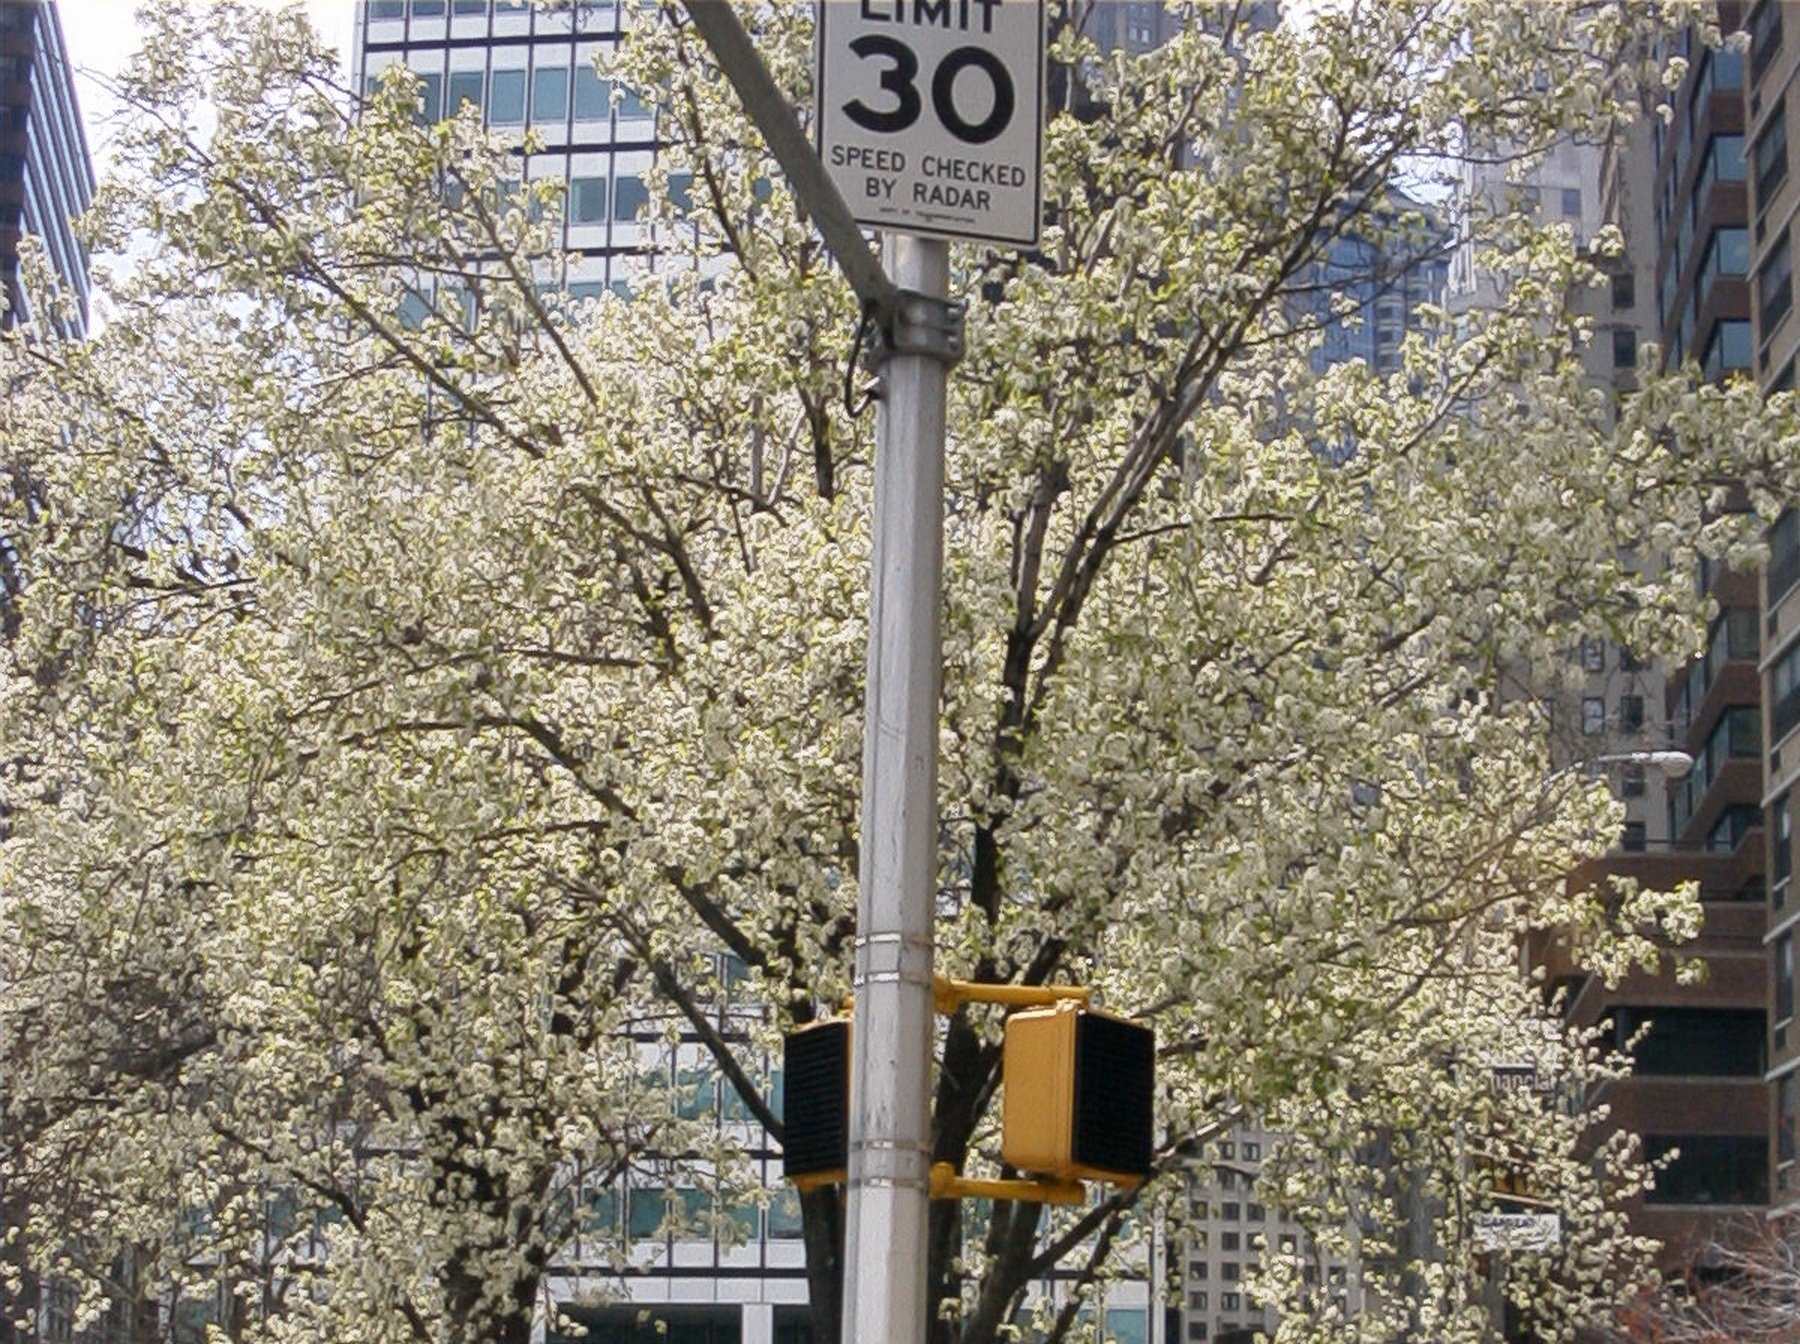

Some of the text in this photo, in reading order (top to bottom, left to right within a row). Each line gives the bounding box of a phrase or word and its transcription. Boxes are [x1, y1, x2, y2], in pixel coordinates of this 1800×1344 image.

[861, 0, 1002, 33] LIMIT
[841, 35, 1015, 145] 30
[831, 145, 1026, 188] SPEED CHECKED
[865, 177, 991, 211] BY RADAR
